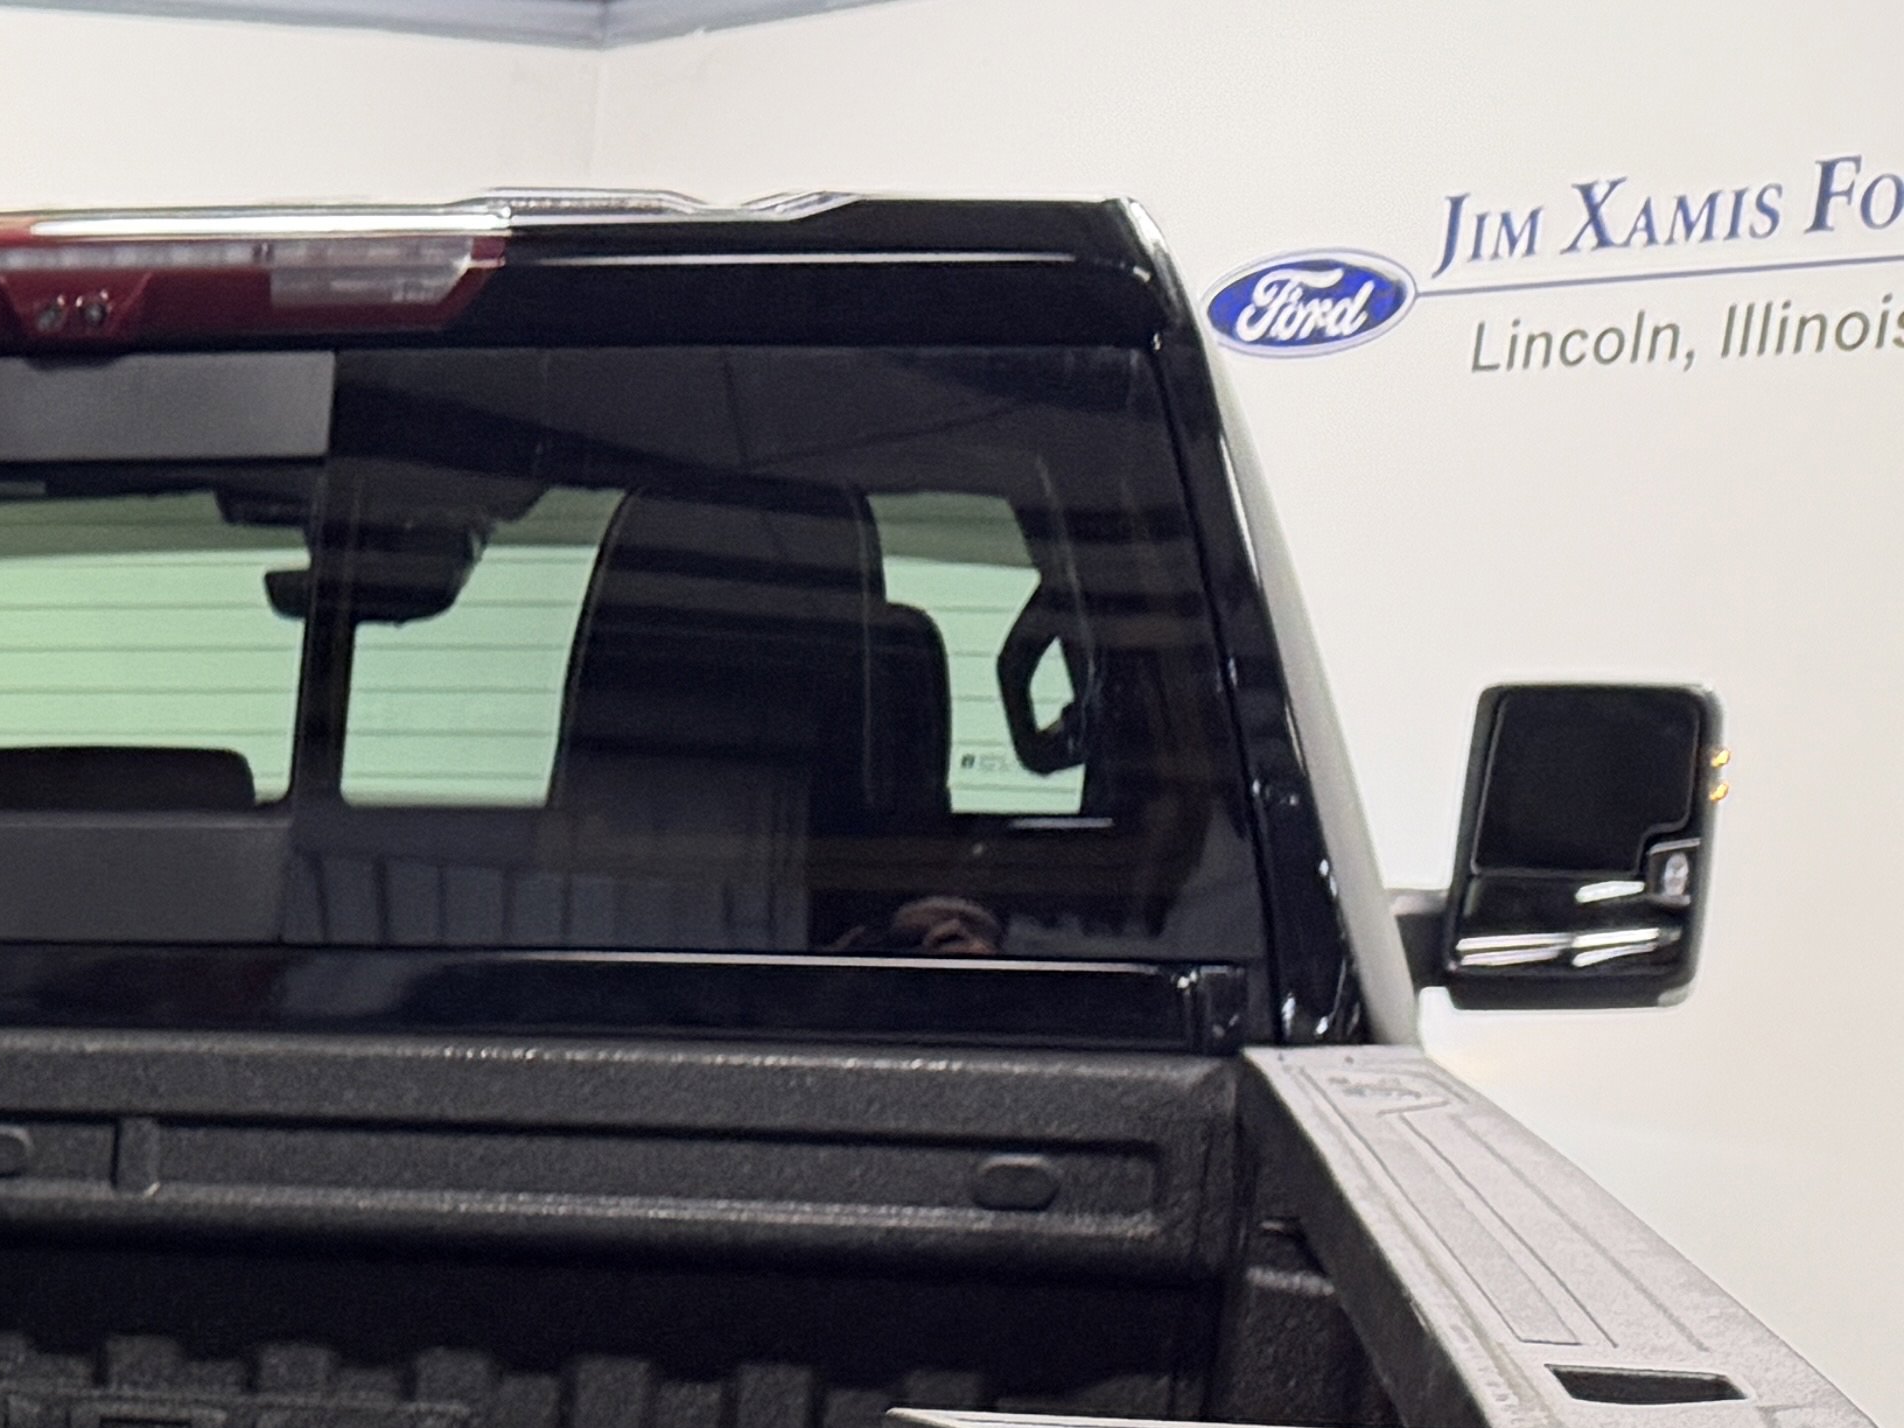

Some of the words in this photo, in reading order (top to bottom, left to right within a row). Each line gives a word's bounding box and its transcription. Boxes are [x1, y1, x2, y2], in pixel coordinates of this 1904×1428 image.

[1432, 192, 1542, 279] JIM
[1559, 177, 1783, 250] XAMIS
[1234, 268, 1375, 343] Ford
[1471, 308, 1695, 375] Lincoln,
